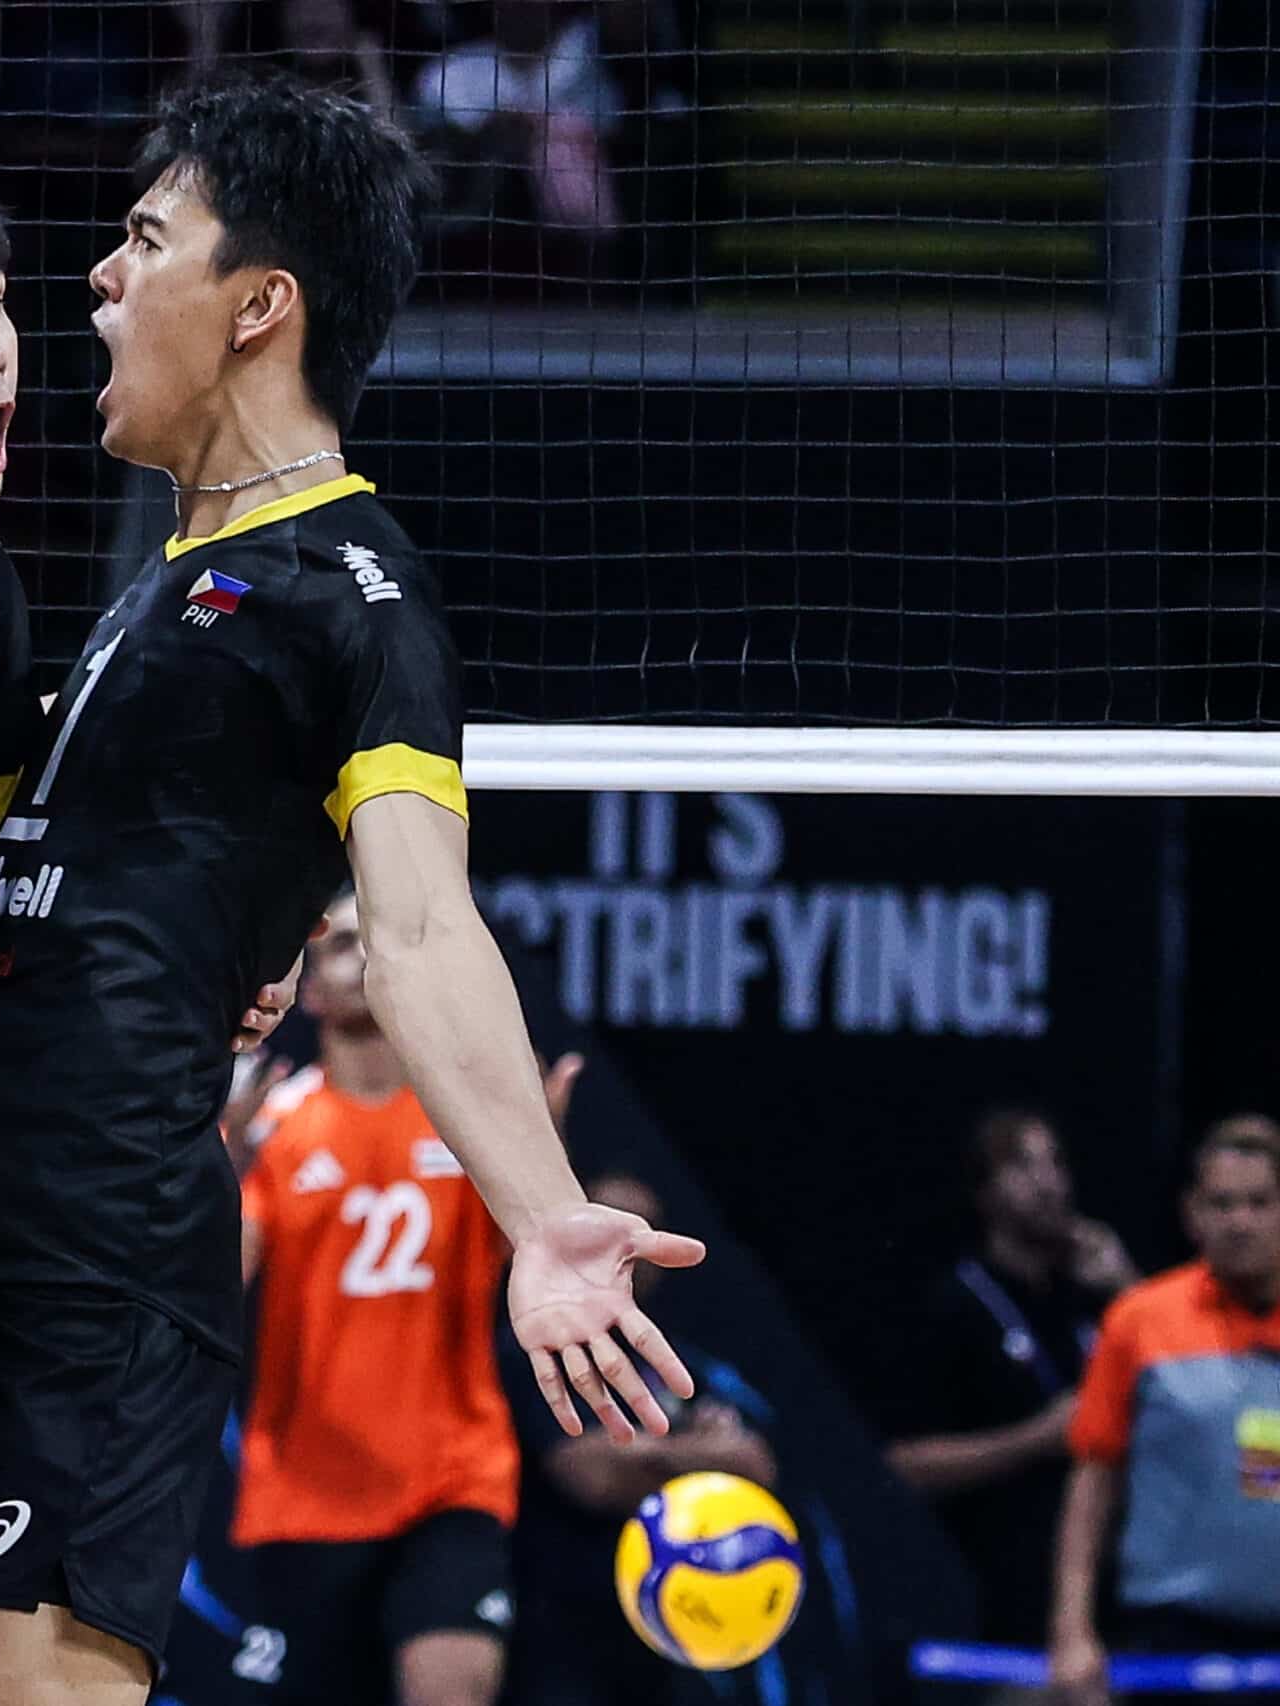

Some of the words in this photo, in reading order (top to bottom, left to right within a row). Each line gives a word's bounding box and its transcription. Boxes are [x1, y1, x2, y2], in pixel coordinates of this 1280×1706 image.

[181, 604, 219, 628] PHI
[589, 790, 784, 880] IS
[338, 1181, 435, 1297] 22
